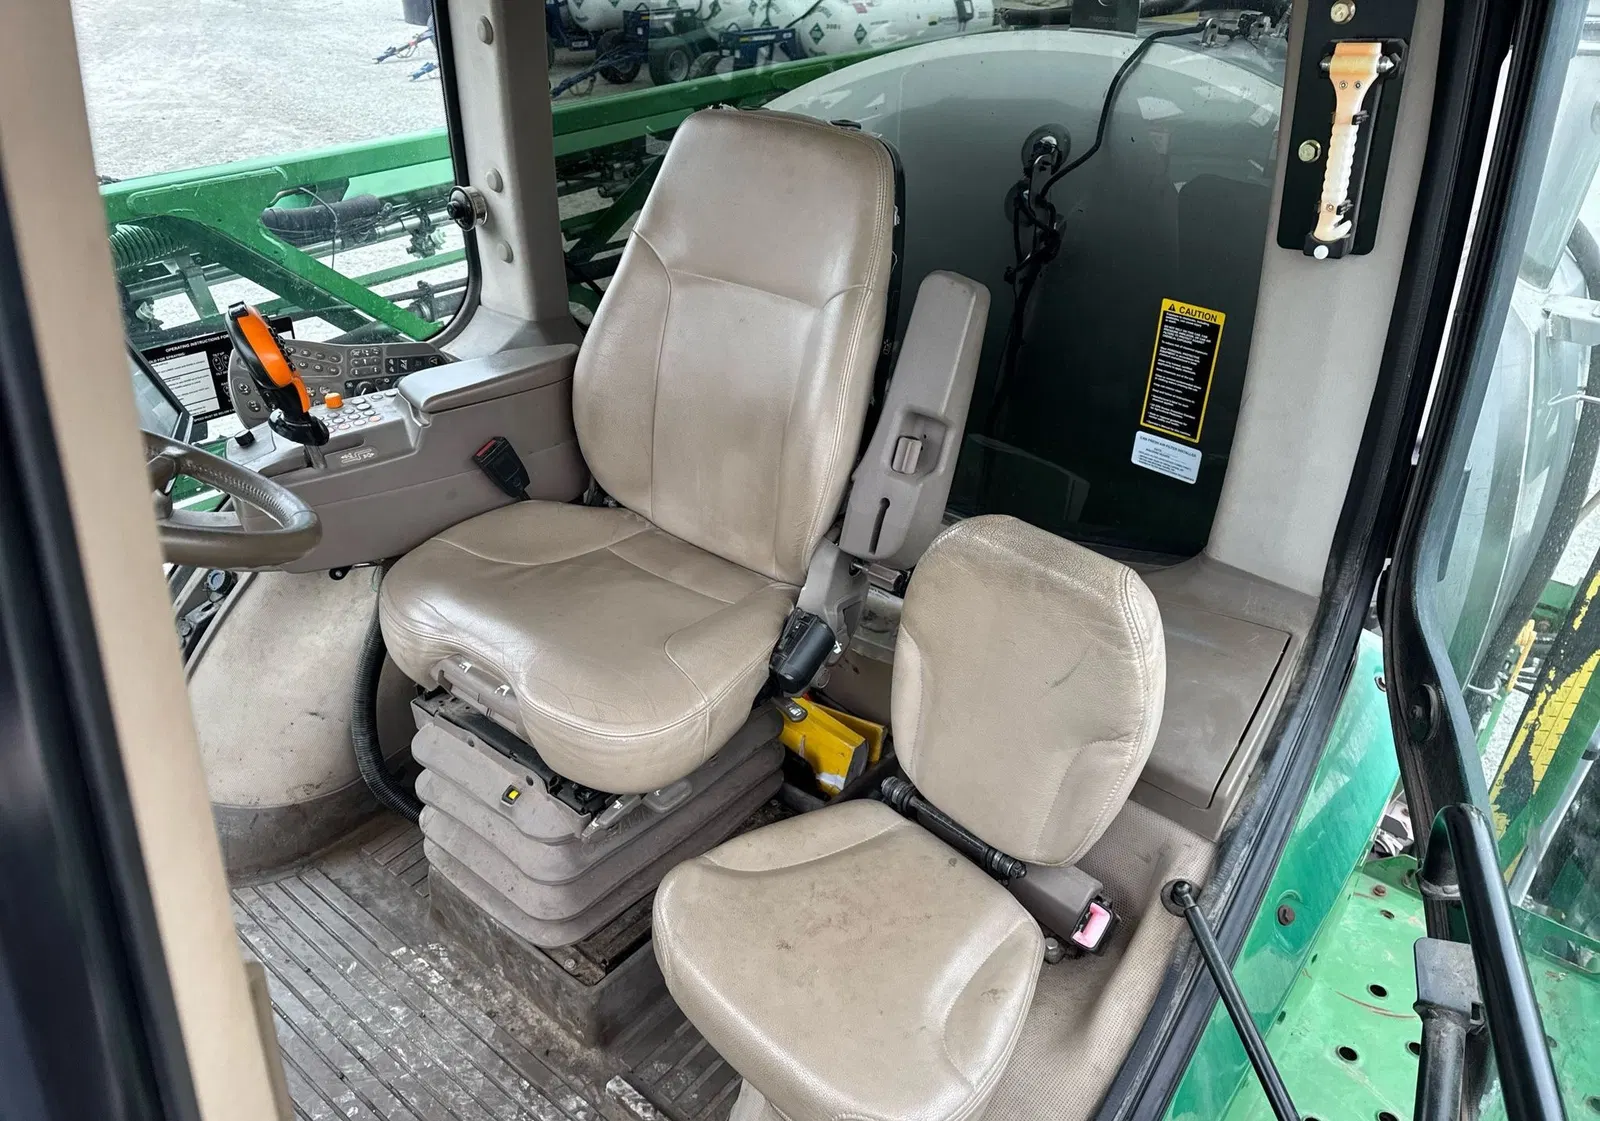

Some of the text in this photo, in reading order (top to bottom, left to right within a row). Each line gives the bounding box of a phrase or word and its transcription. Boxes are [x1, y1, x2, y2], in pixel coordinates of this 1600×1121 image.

[1179, 306, 1217, 322] CAUTION
[165, 344, 190, 353] OPERATING
[190, 337, 220, 347] INSTRUCTIONS
